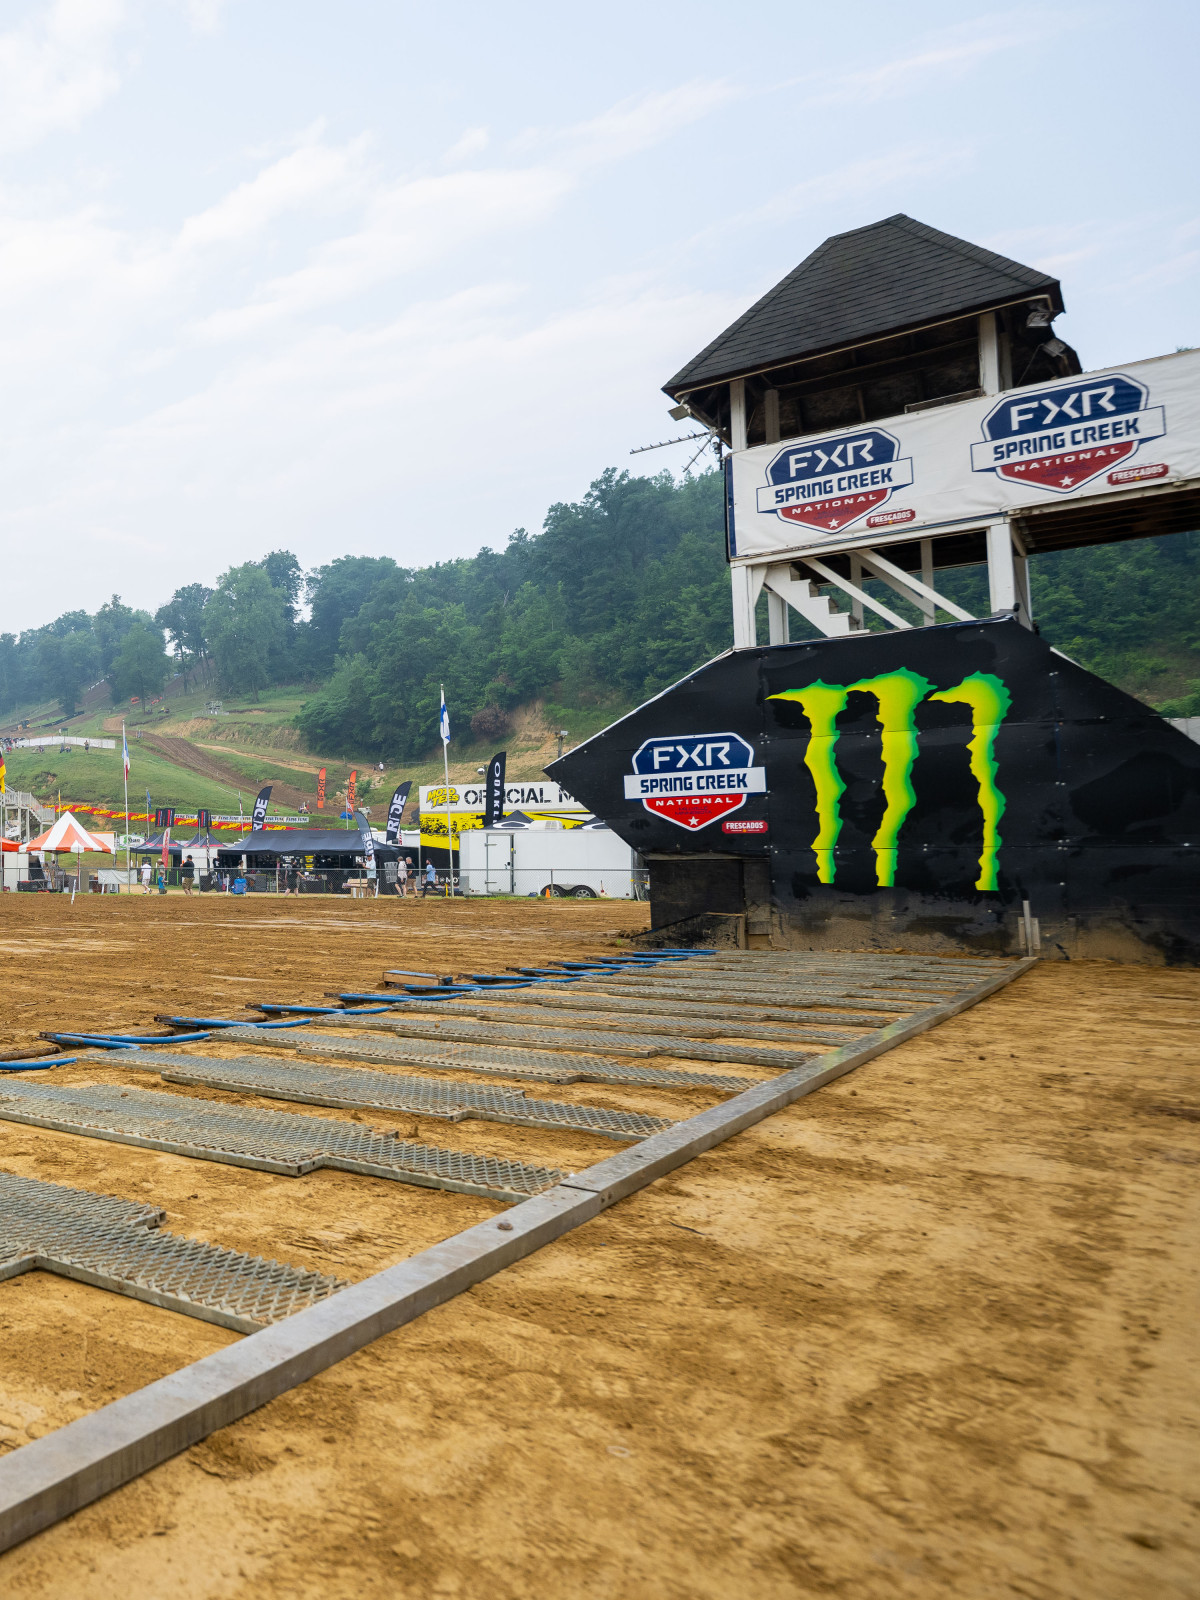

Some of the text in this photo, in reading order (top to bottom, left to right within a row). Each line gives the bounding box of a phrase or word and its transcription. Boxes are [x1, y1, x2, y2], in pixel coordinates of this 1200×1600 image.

[1010, 385, 1117, 431] FXR
[993, 417, 1140, 461] SPRING CREEK
[788, 438, 875, 478] FXR
[1013, 448, 1120, 473] NATIONAL
[1111, 465, 1164, 481] FRESCADOS
[774, 467, 893, 505] SPRING CREEK
[791, 494, 878, 515] NATIONAL
[870, 510, 911, 525] FRESCADOS
[653, 742, 731, 770] FXR
[640, 773, 748, 793] SPRING CREEK
[427, 788, 456, 801] MOTO
[655, 797, 733, 807] NATIONAL
[725, 822, 763, 830] FRESCADOS
